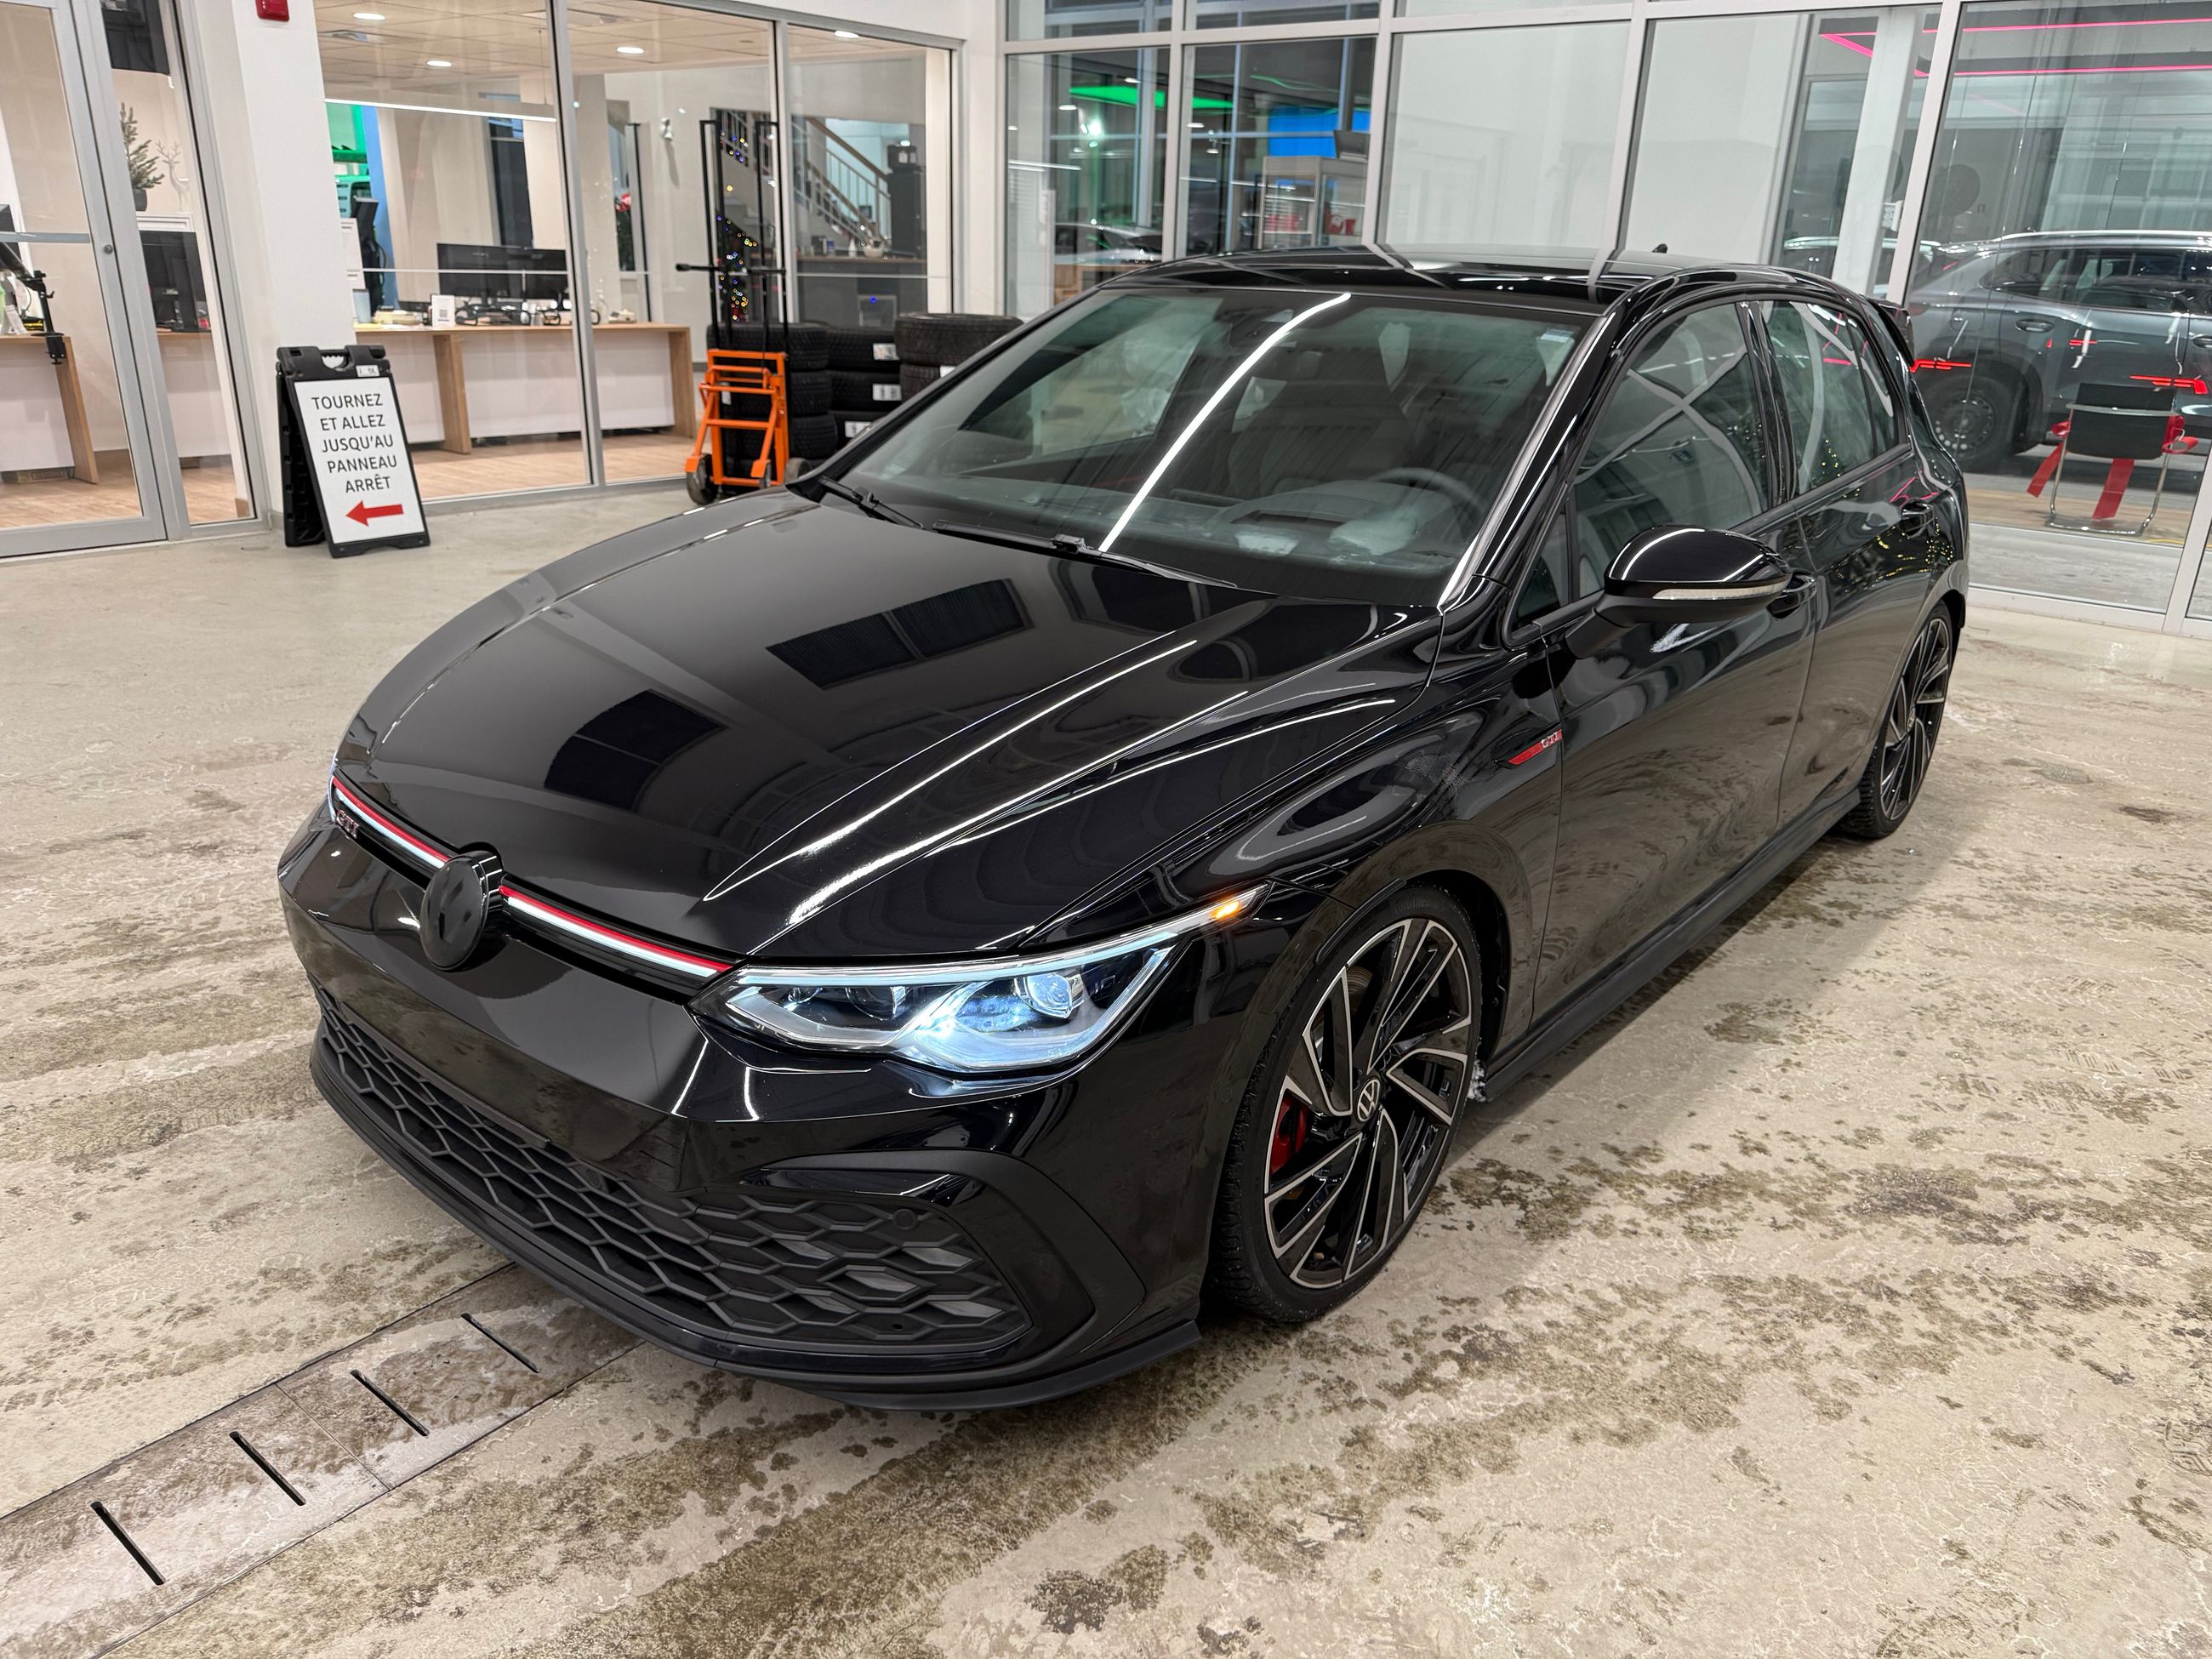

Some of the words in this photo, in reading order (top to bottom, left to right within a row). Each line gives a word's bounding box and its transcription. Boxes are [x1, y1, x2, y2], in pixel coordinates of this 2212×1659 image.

[311, 393, 383, 409] TOURNEZ
[320, 418, 337, 431] ET
[342, 414, 385, 430] ALLEZ
[322, 435, 393, 453] JUSQU'AU
[327, 455, 397, 473] PANNEAU
[345, 474, 391, 493] ARRÊT
[1541, 732, 1558, 749] GTI
[336, 809, 360, 839] GTI
